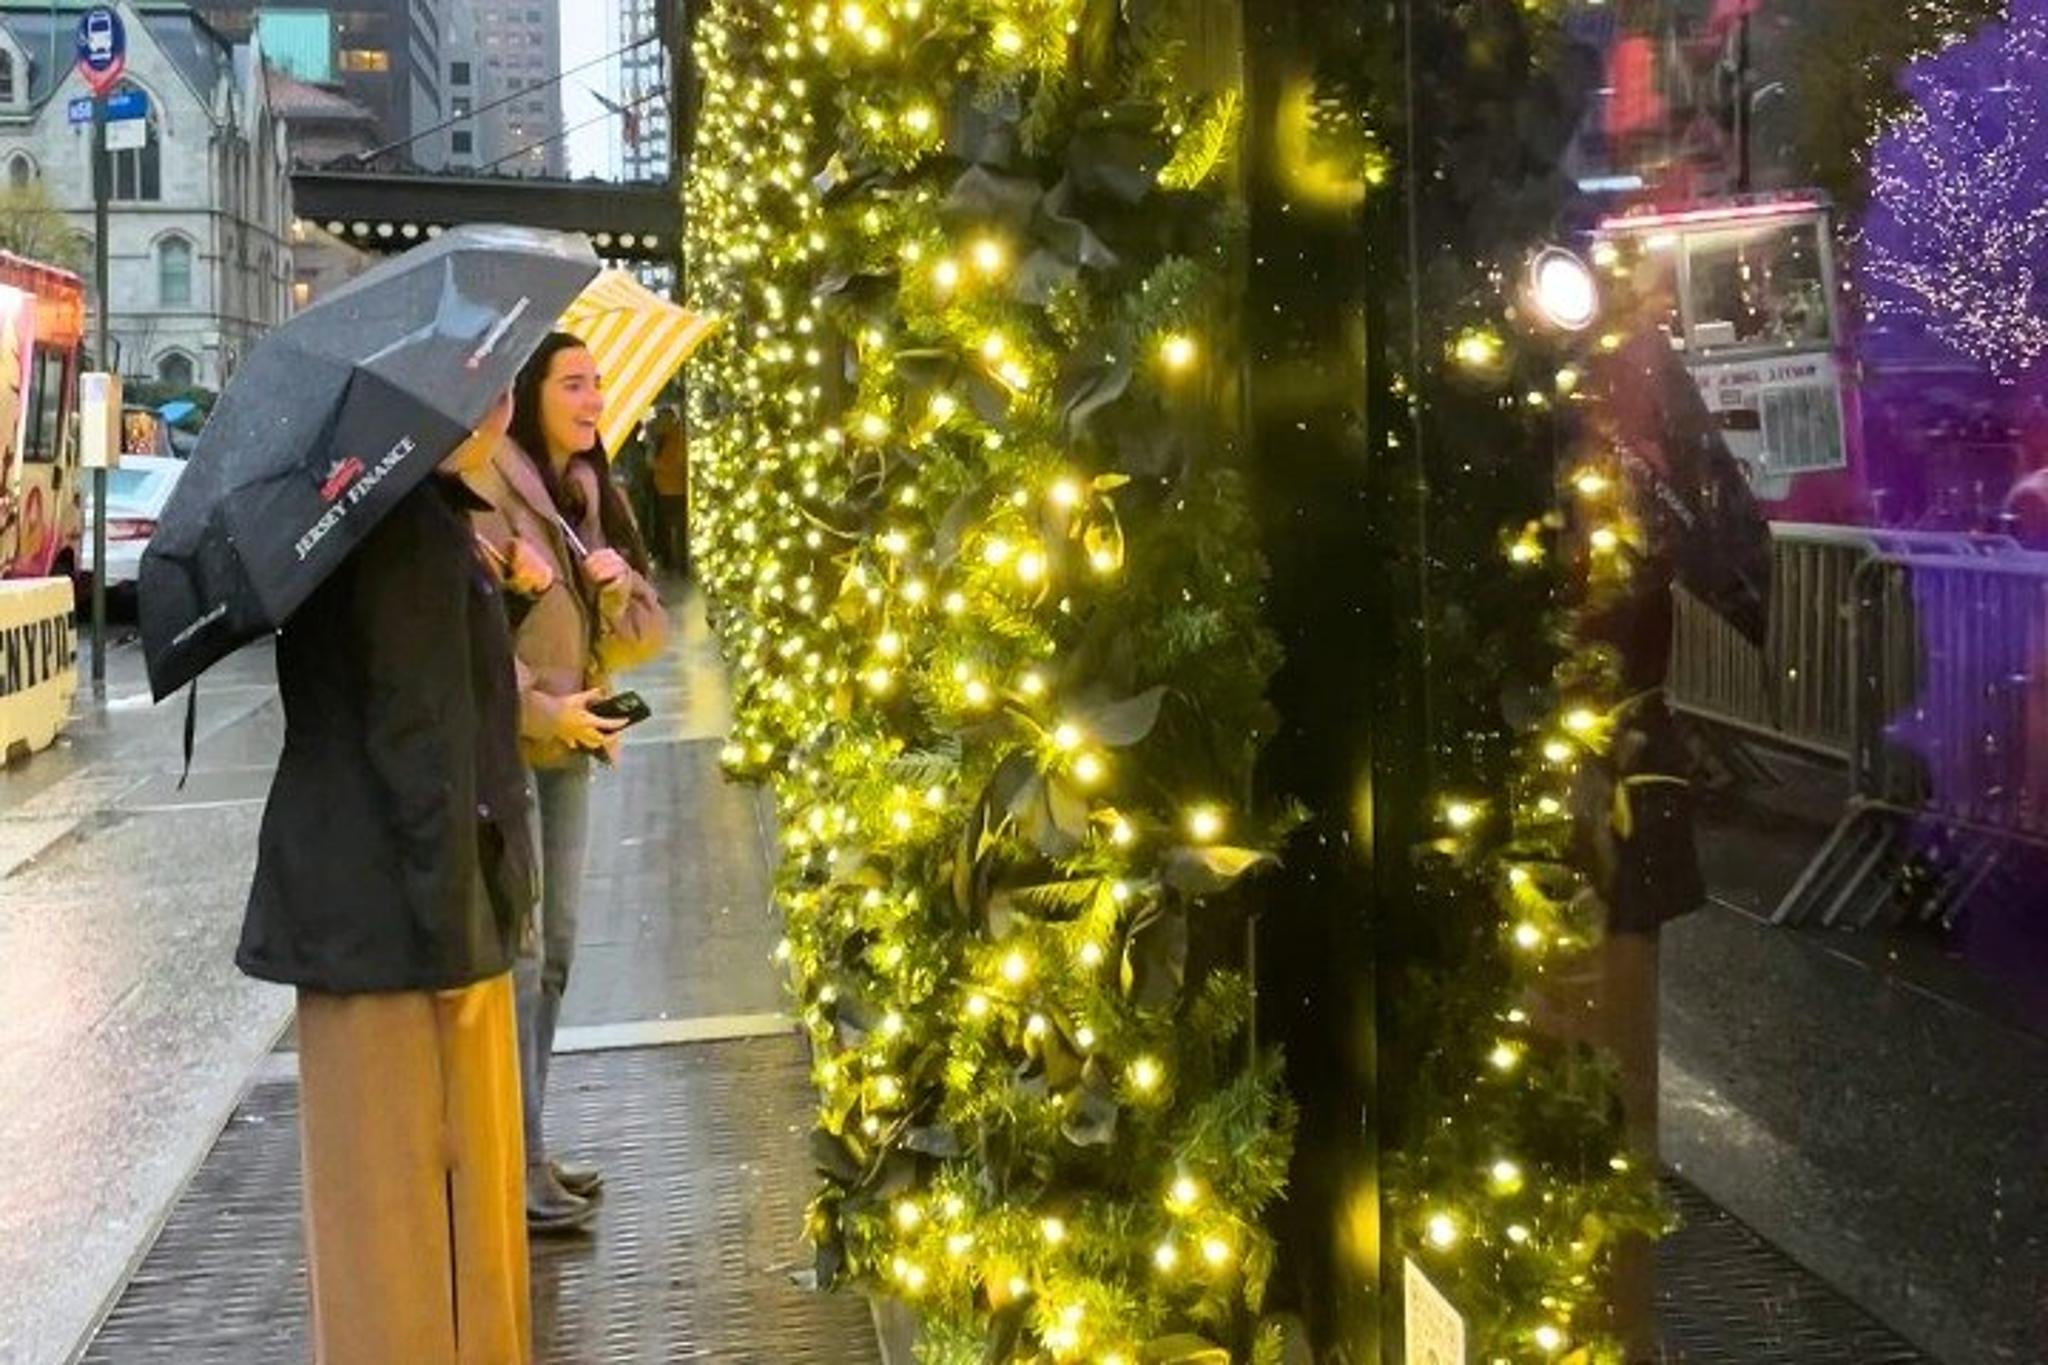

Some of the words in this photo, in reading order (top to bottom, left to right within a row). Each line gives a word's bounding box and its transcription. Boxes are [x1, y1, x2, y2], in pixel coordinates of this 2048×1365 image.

[294, 500, 347, 562] JERSEY
[346, 434, 417, 504] FINANCE
[6, 613, 68, 695] NYPD
